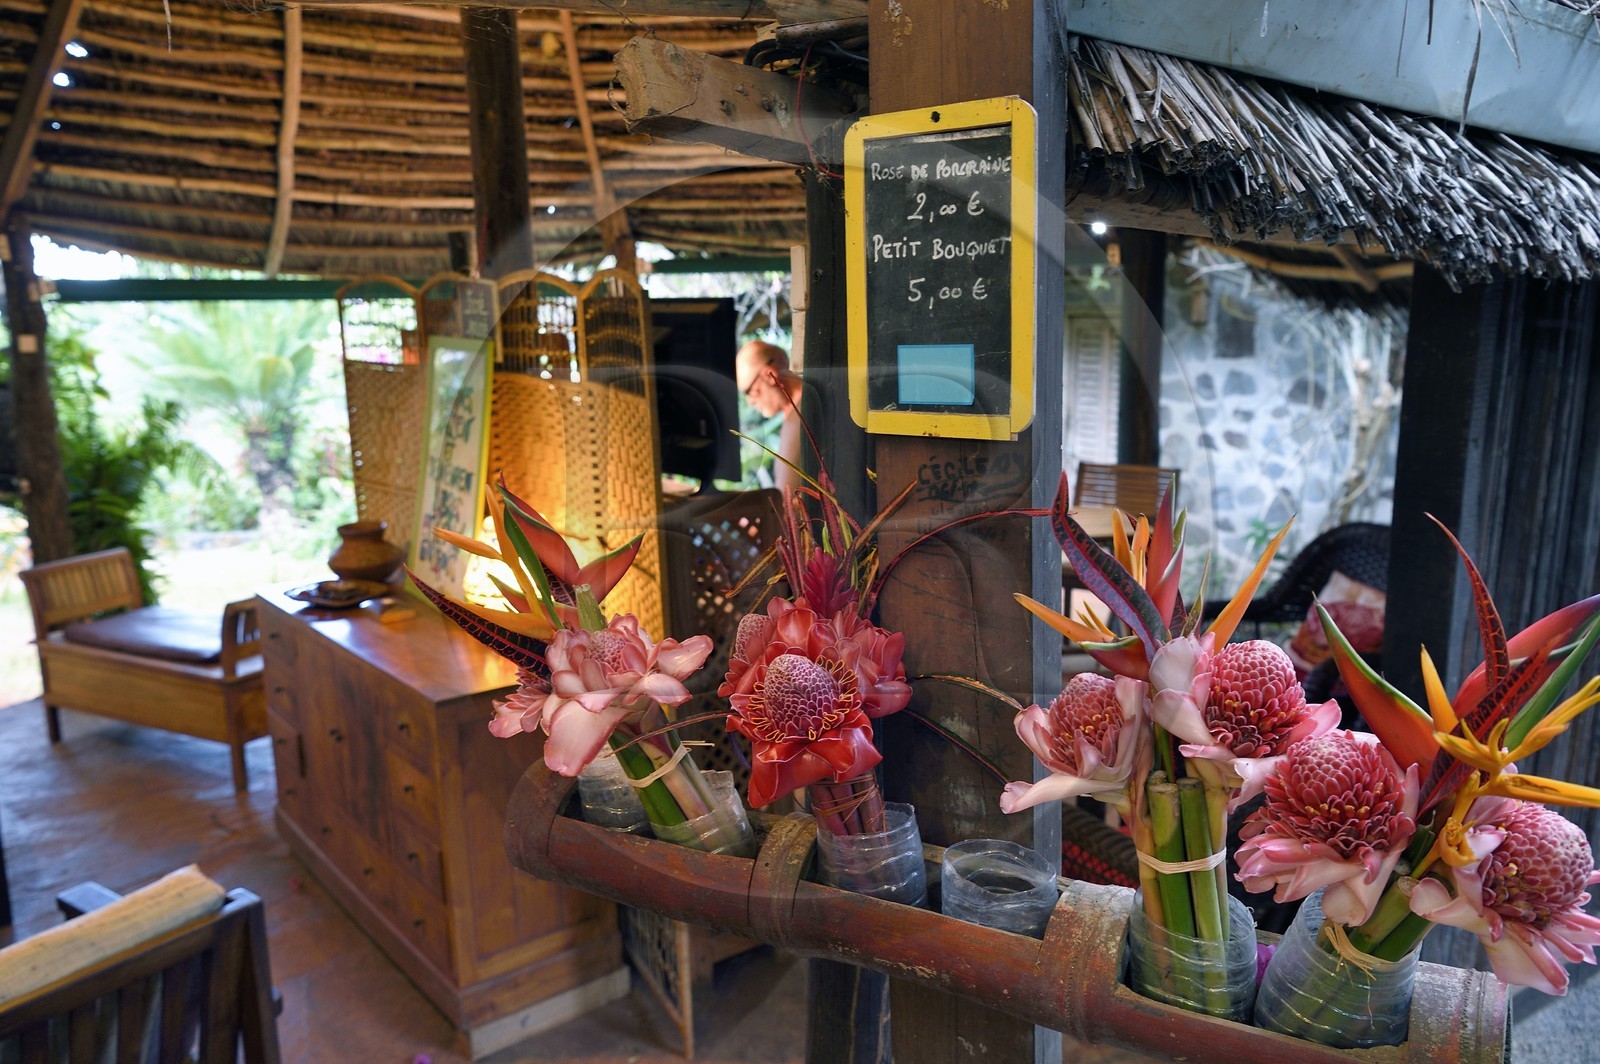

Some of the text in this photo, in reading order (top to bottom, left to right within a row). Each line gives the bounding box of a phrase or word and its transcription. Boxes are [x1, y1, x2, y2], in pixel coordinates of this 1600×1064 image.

[871, 163, 905, 181] ROSE
[911, 163, 928, 180] DE
[907, 191, 984, 223] 2,00 €
[873, 235, 1011, 262] PETIT BOUQUET
[908, 278, 988, 309] 5,00 €
